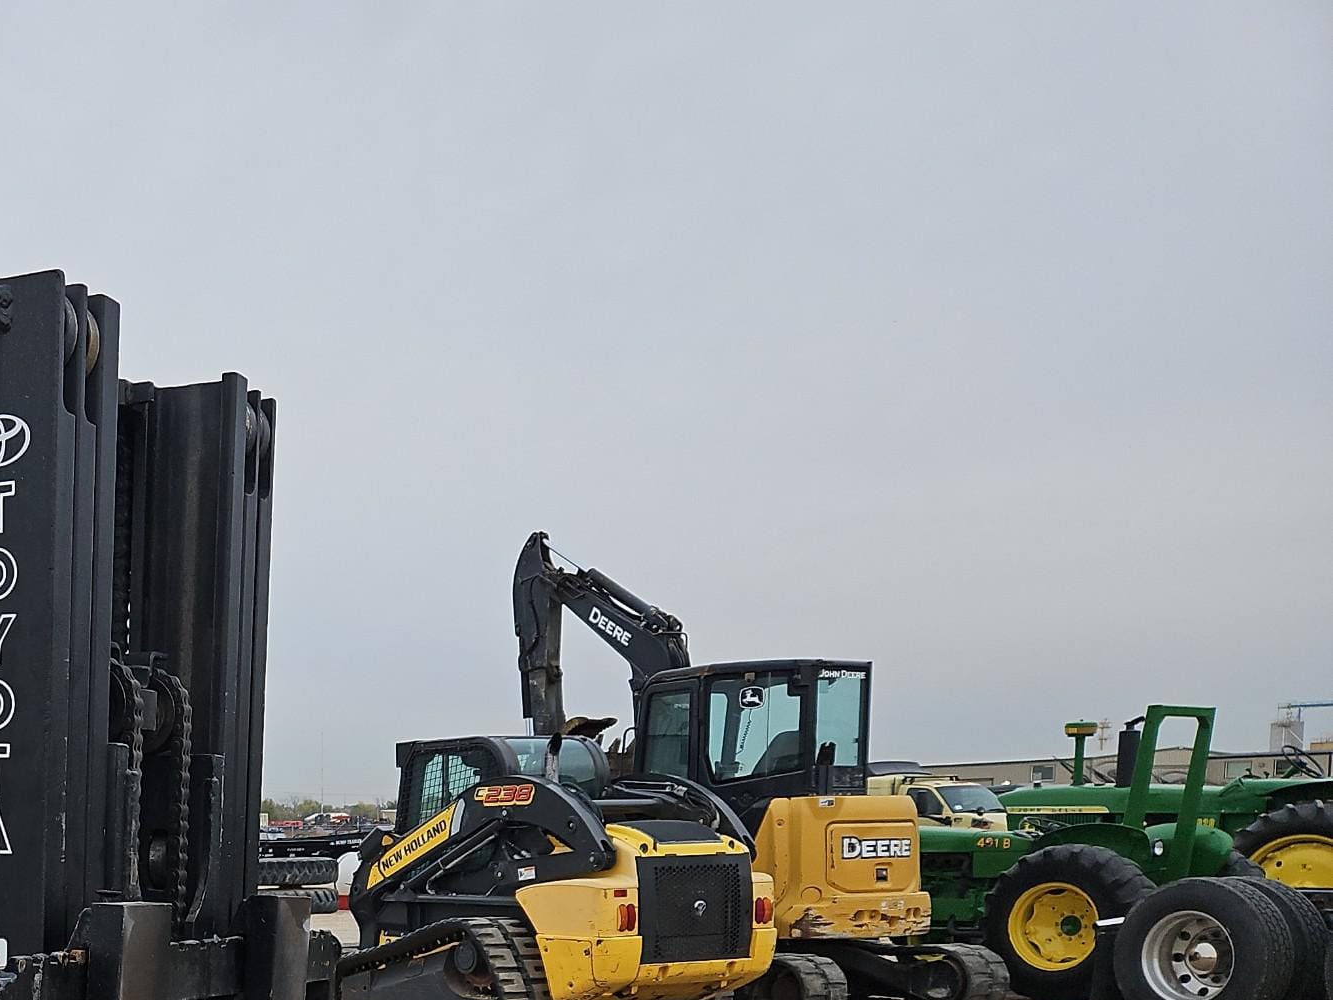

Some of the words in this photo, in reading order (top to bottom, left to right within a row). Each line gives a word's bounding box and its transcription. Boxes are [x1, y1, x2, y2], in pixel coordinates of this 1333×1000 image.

[588, 606, 632, 647] DEERE
[818, 669, 841, 678] JOHN
[841, 670, 867, 679] DEERE
[473, 784, 536, 807] C238
[382, 850, 405, 871] NEW
[403, 819, 447, 857] HOLLAND
[842, 837, 912, 860] DEERE
